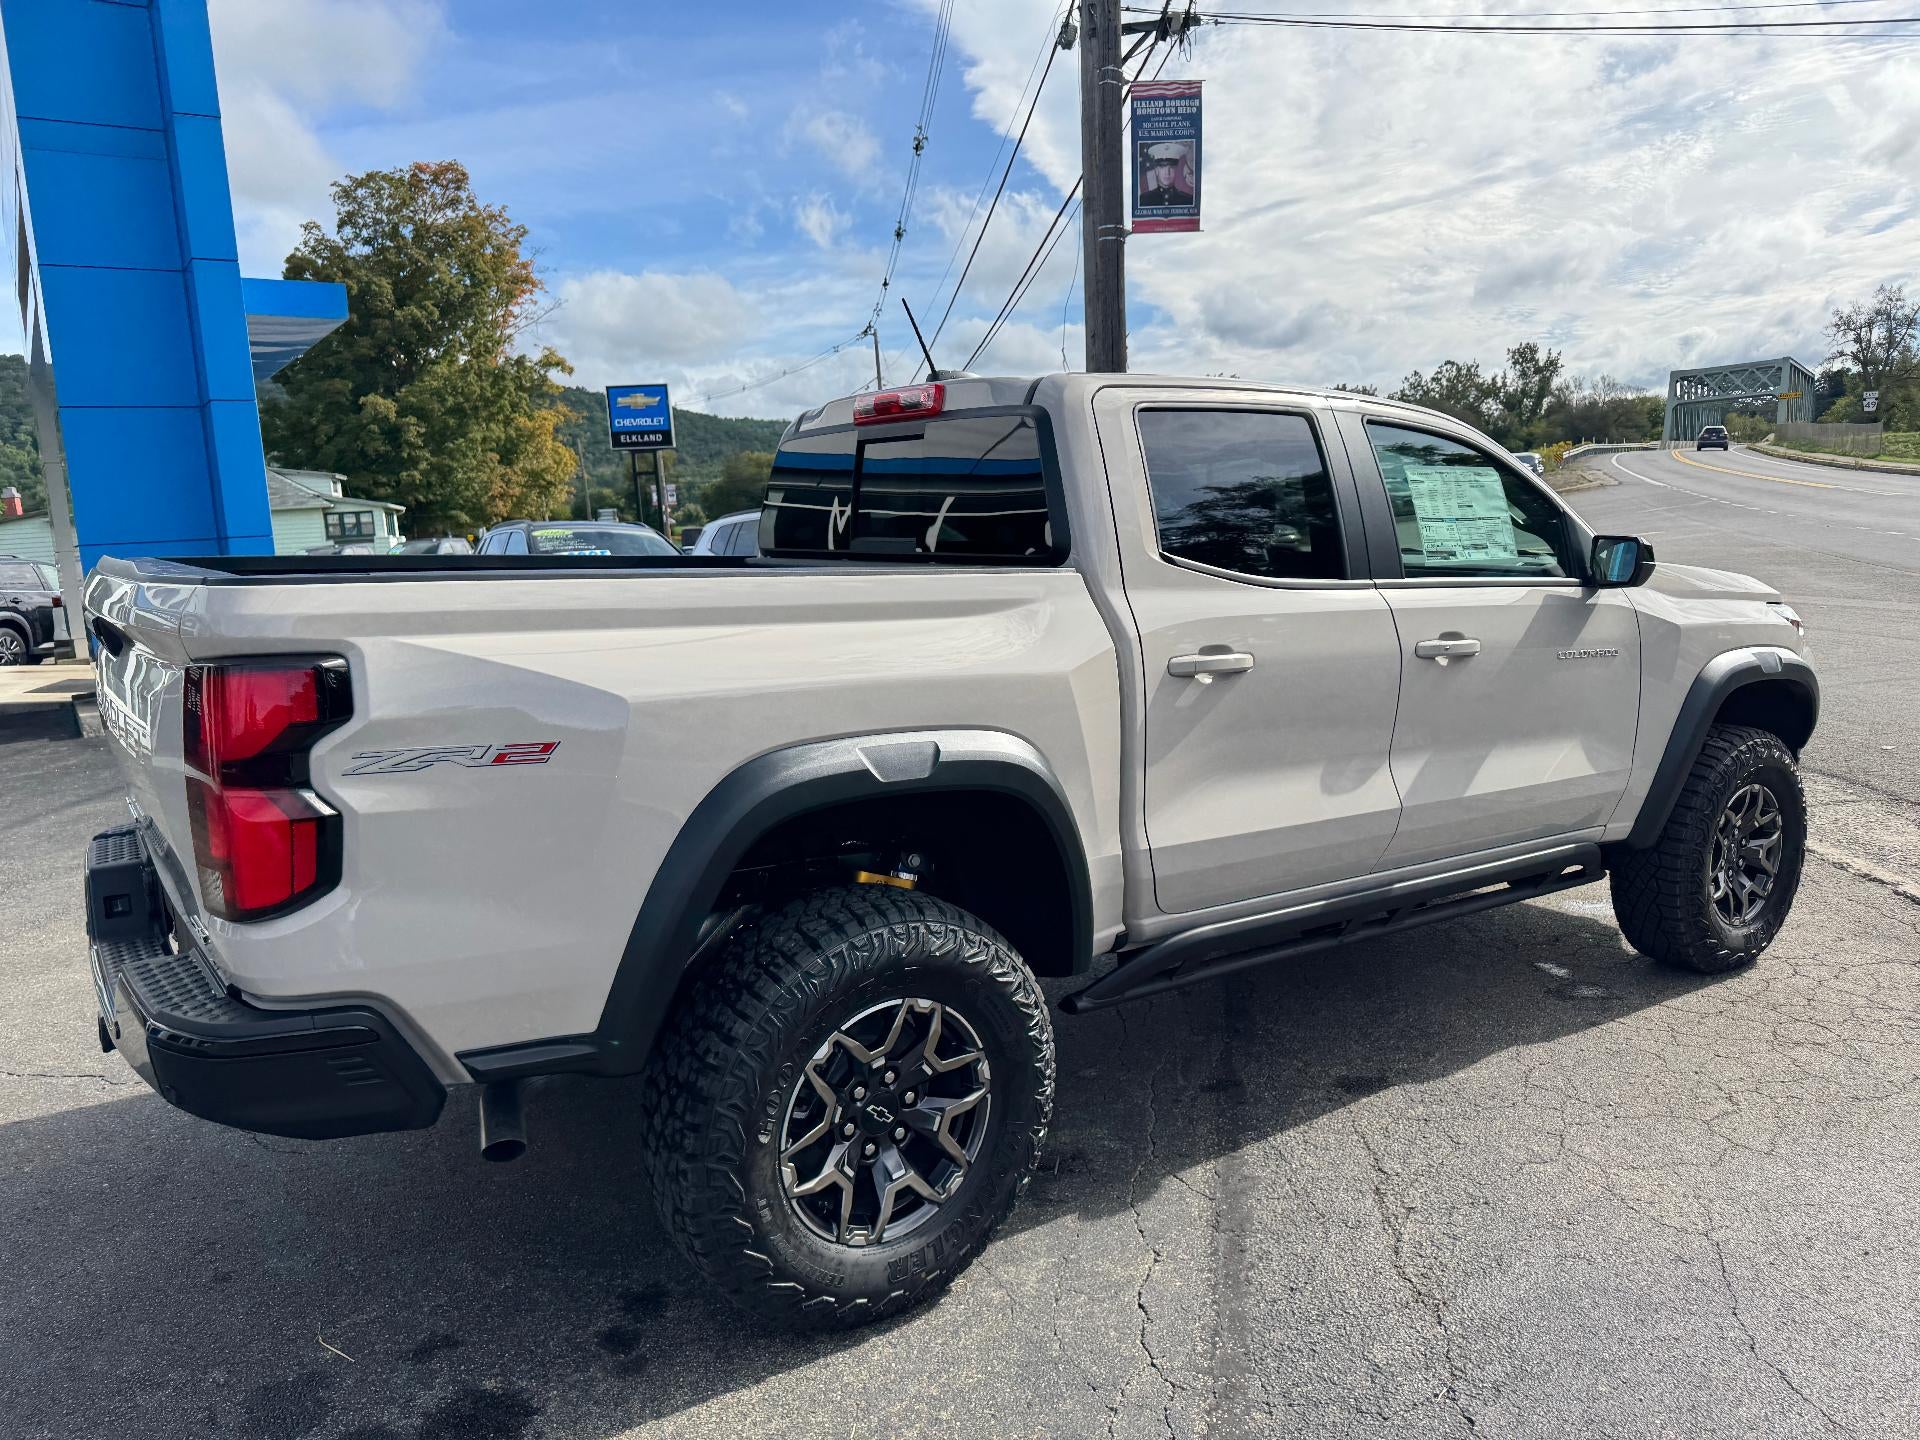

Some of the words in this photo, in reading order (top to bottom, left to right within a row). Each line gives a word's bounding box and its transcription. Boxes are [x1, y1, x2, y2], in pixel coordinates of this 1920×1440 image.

[1133, 100, 1164, 108] ELKLAND
[1165, 99, 1200, 107] BOROUGH
[1136, 107, 1176, 115] HOMETOWN
[1177, 106, 1197, 114] HERO
[1150, 129, 1174, 137] MARINE
[615, 417, 664, 427] CHEVROLET
[620, 434, 662, 443] ELKLAND
[1557, 648, 1619, 659] COLORADO
[341, 741, 562, 776] ZR2
